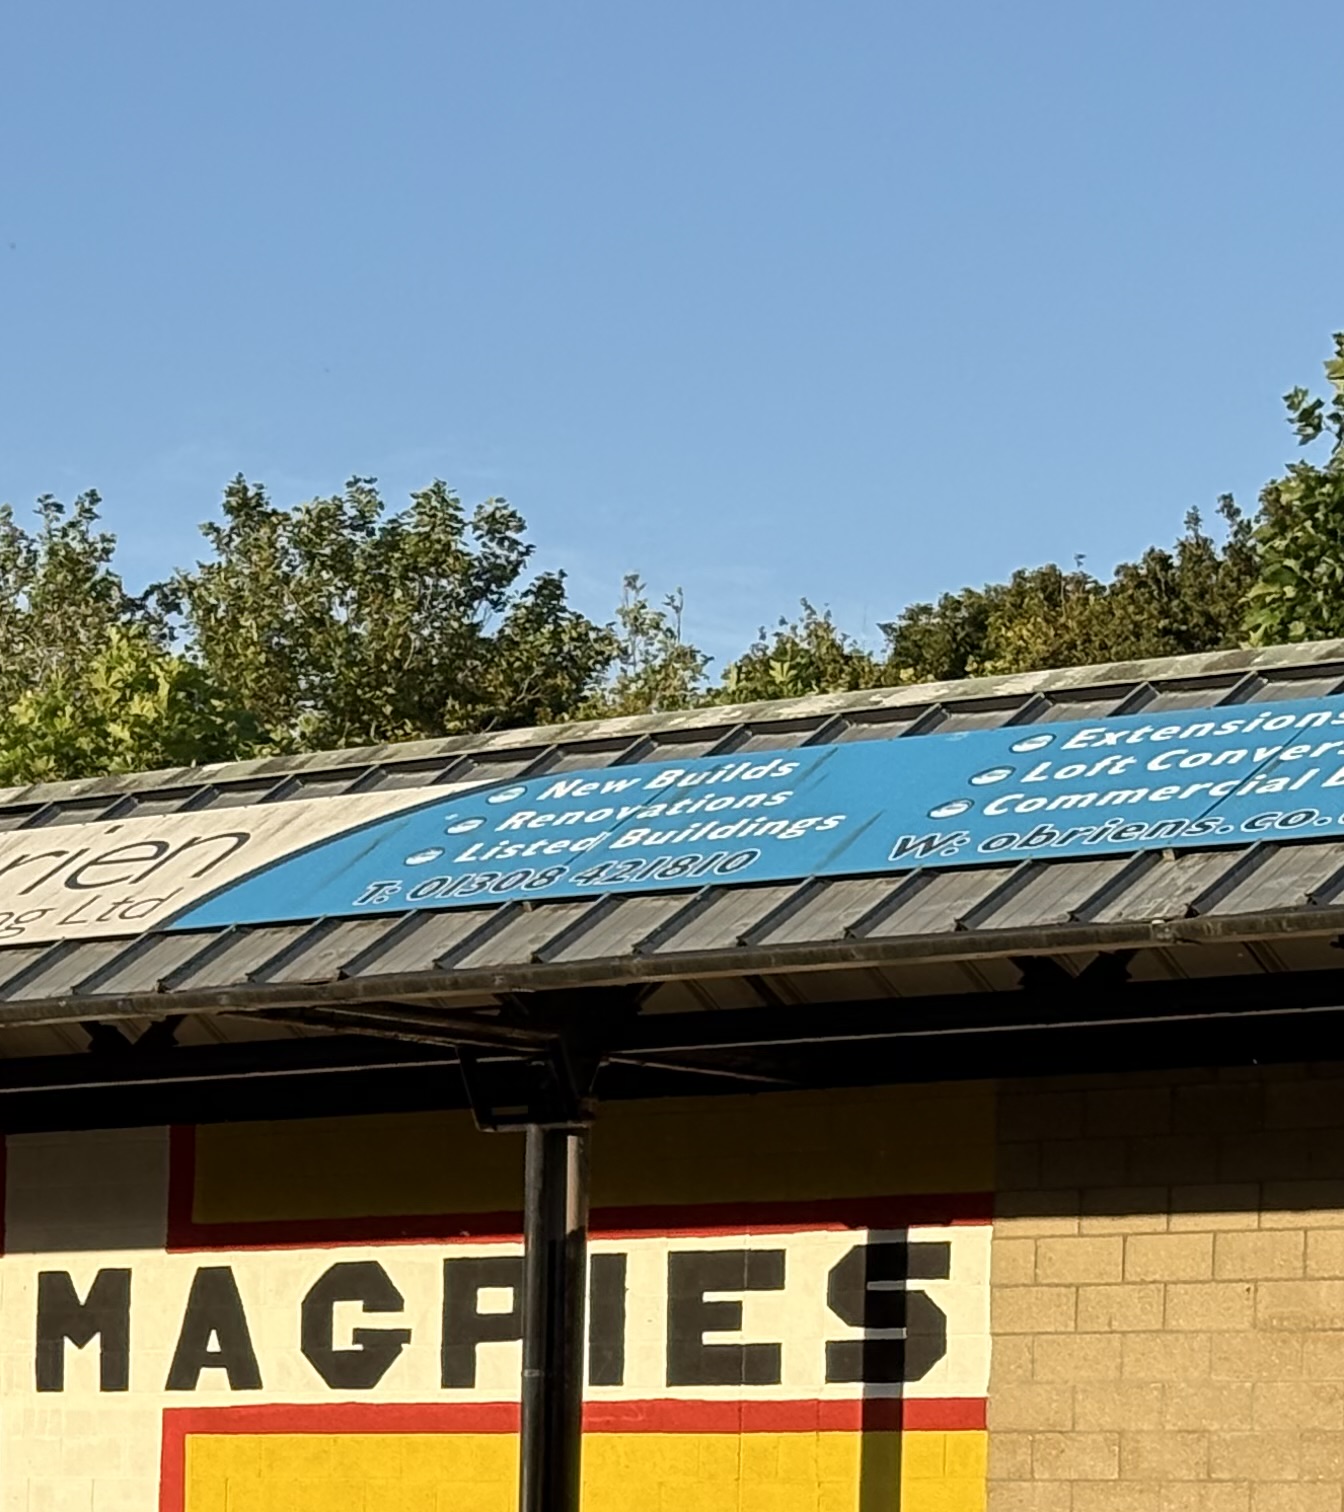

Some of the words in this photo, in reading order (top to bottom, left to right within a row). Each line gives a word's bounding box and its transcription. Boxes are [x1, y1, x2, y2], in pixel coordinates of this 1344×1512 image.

[536, 777, 642, 801] New
[645, 758, 802, 791] Builds
[1020, 755, 1138, 784] Loft
[1146, 741, 1344, 771] Conver
[495, 788, 795, 832] Renovations
[983, 768, 1320, 816] Commercial
[453, 831, 608, 864] Listed
[609, 813, 847, 851] Buildings
[977, 808, 1344, 854] obriens.co.
[406, 864, 567, 903] 01308
[571, 848, 761, 888] 421810
[57, 887, 184, 926] Ltd
[35, 1240, 951, 1392] MAGPIES
